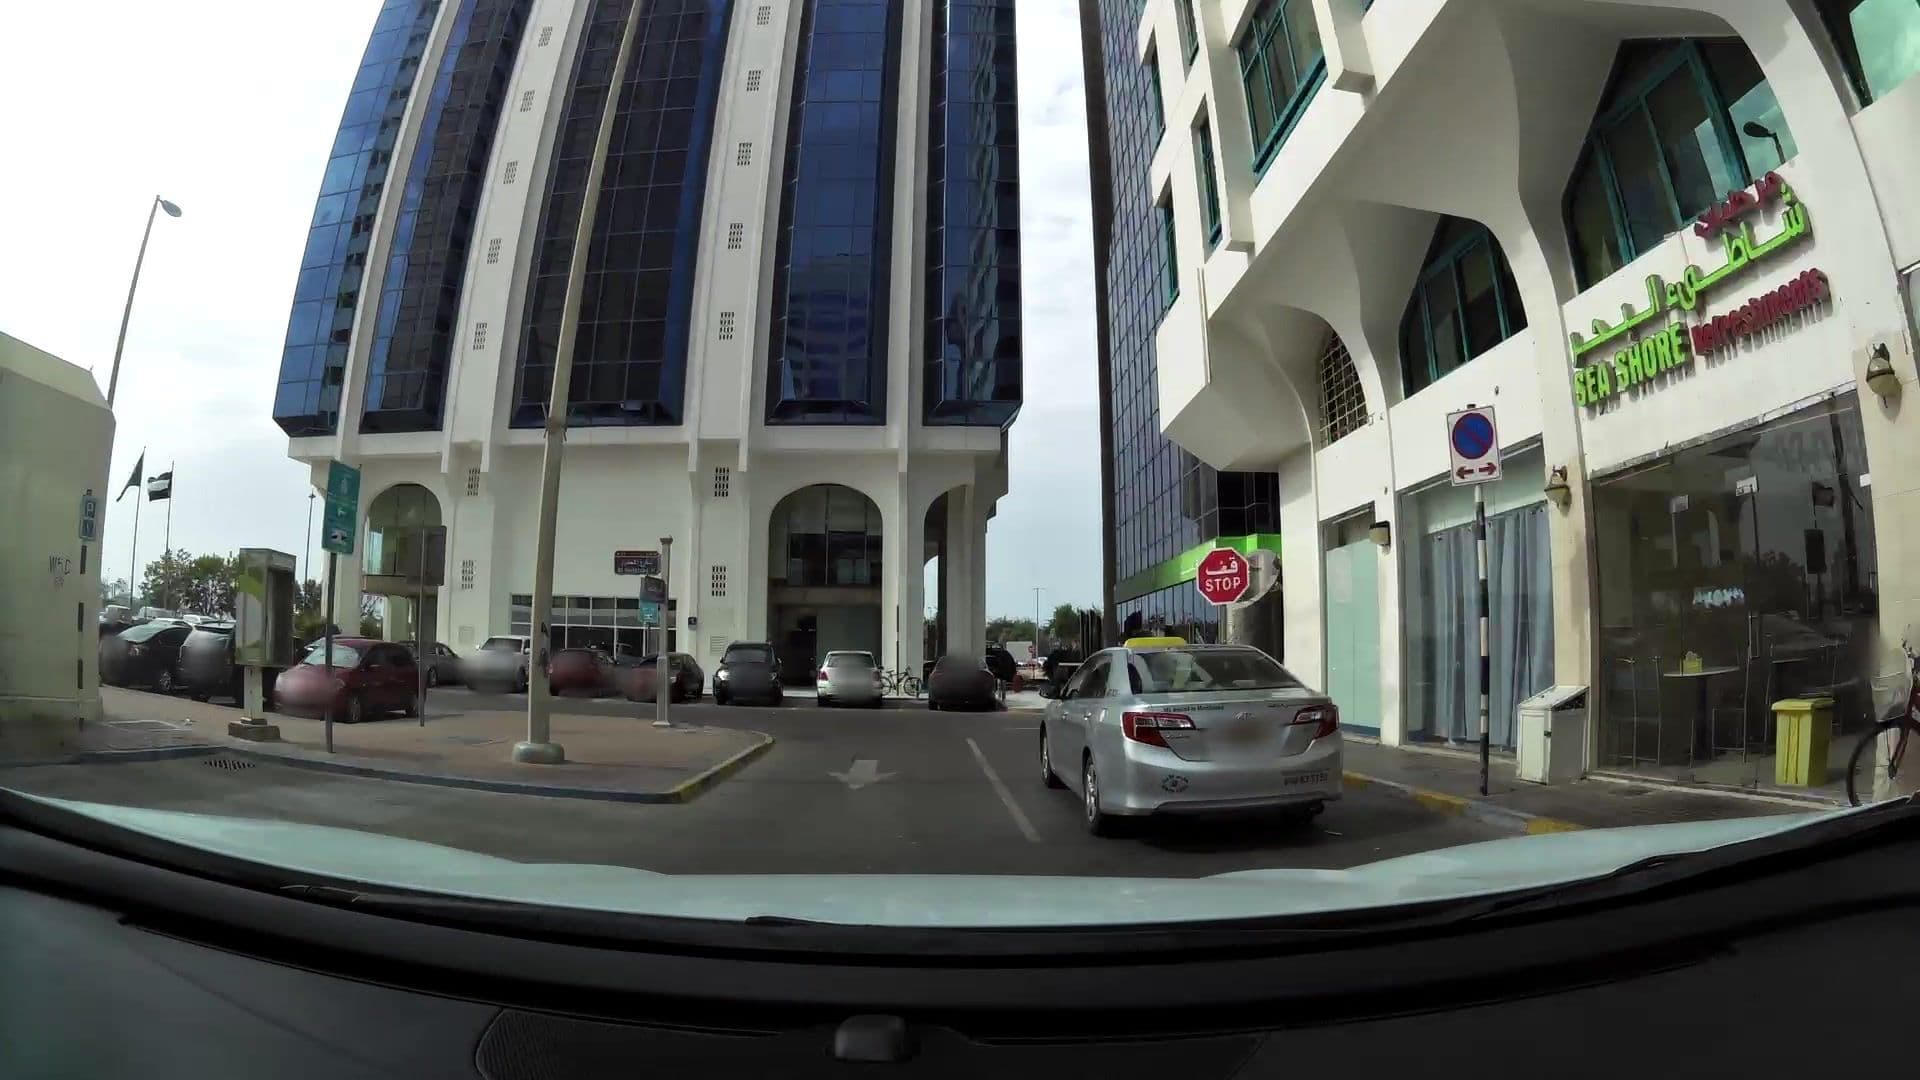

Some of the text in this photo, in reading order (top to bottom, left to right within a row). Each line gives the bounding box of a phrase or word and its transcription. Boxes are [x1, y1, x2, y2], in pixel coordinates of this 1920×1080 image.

[1573, 361, 1613, 408] SEA
[1614, 321, 1688, 393] SHORE
[1205, 555, 1239, 576] قف
[1205, 576, 1241, 592] STOP
